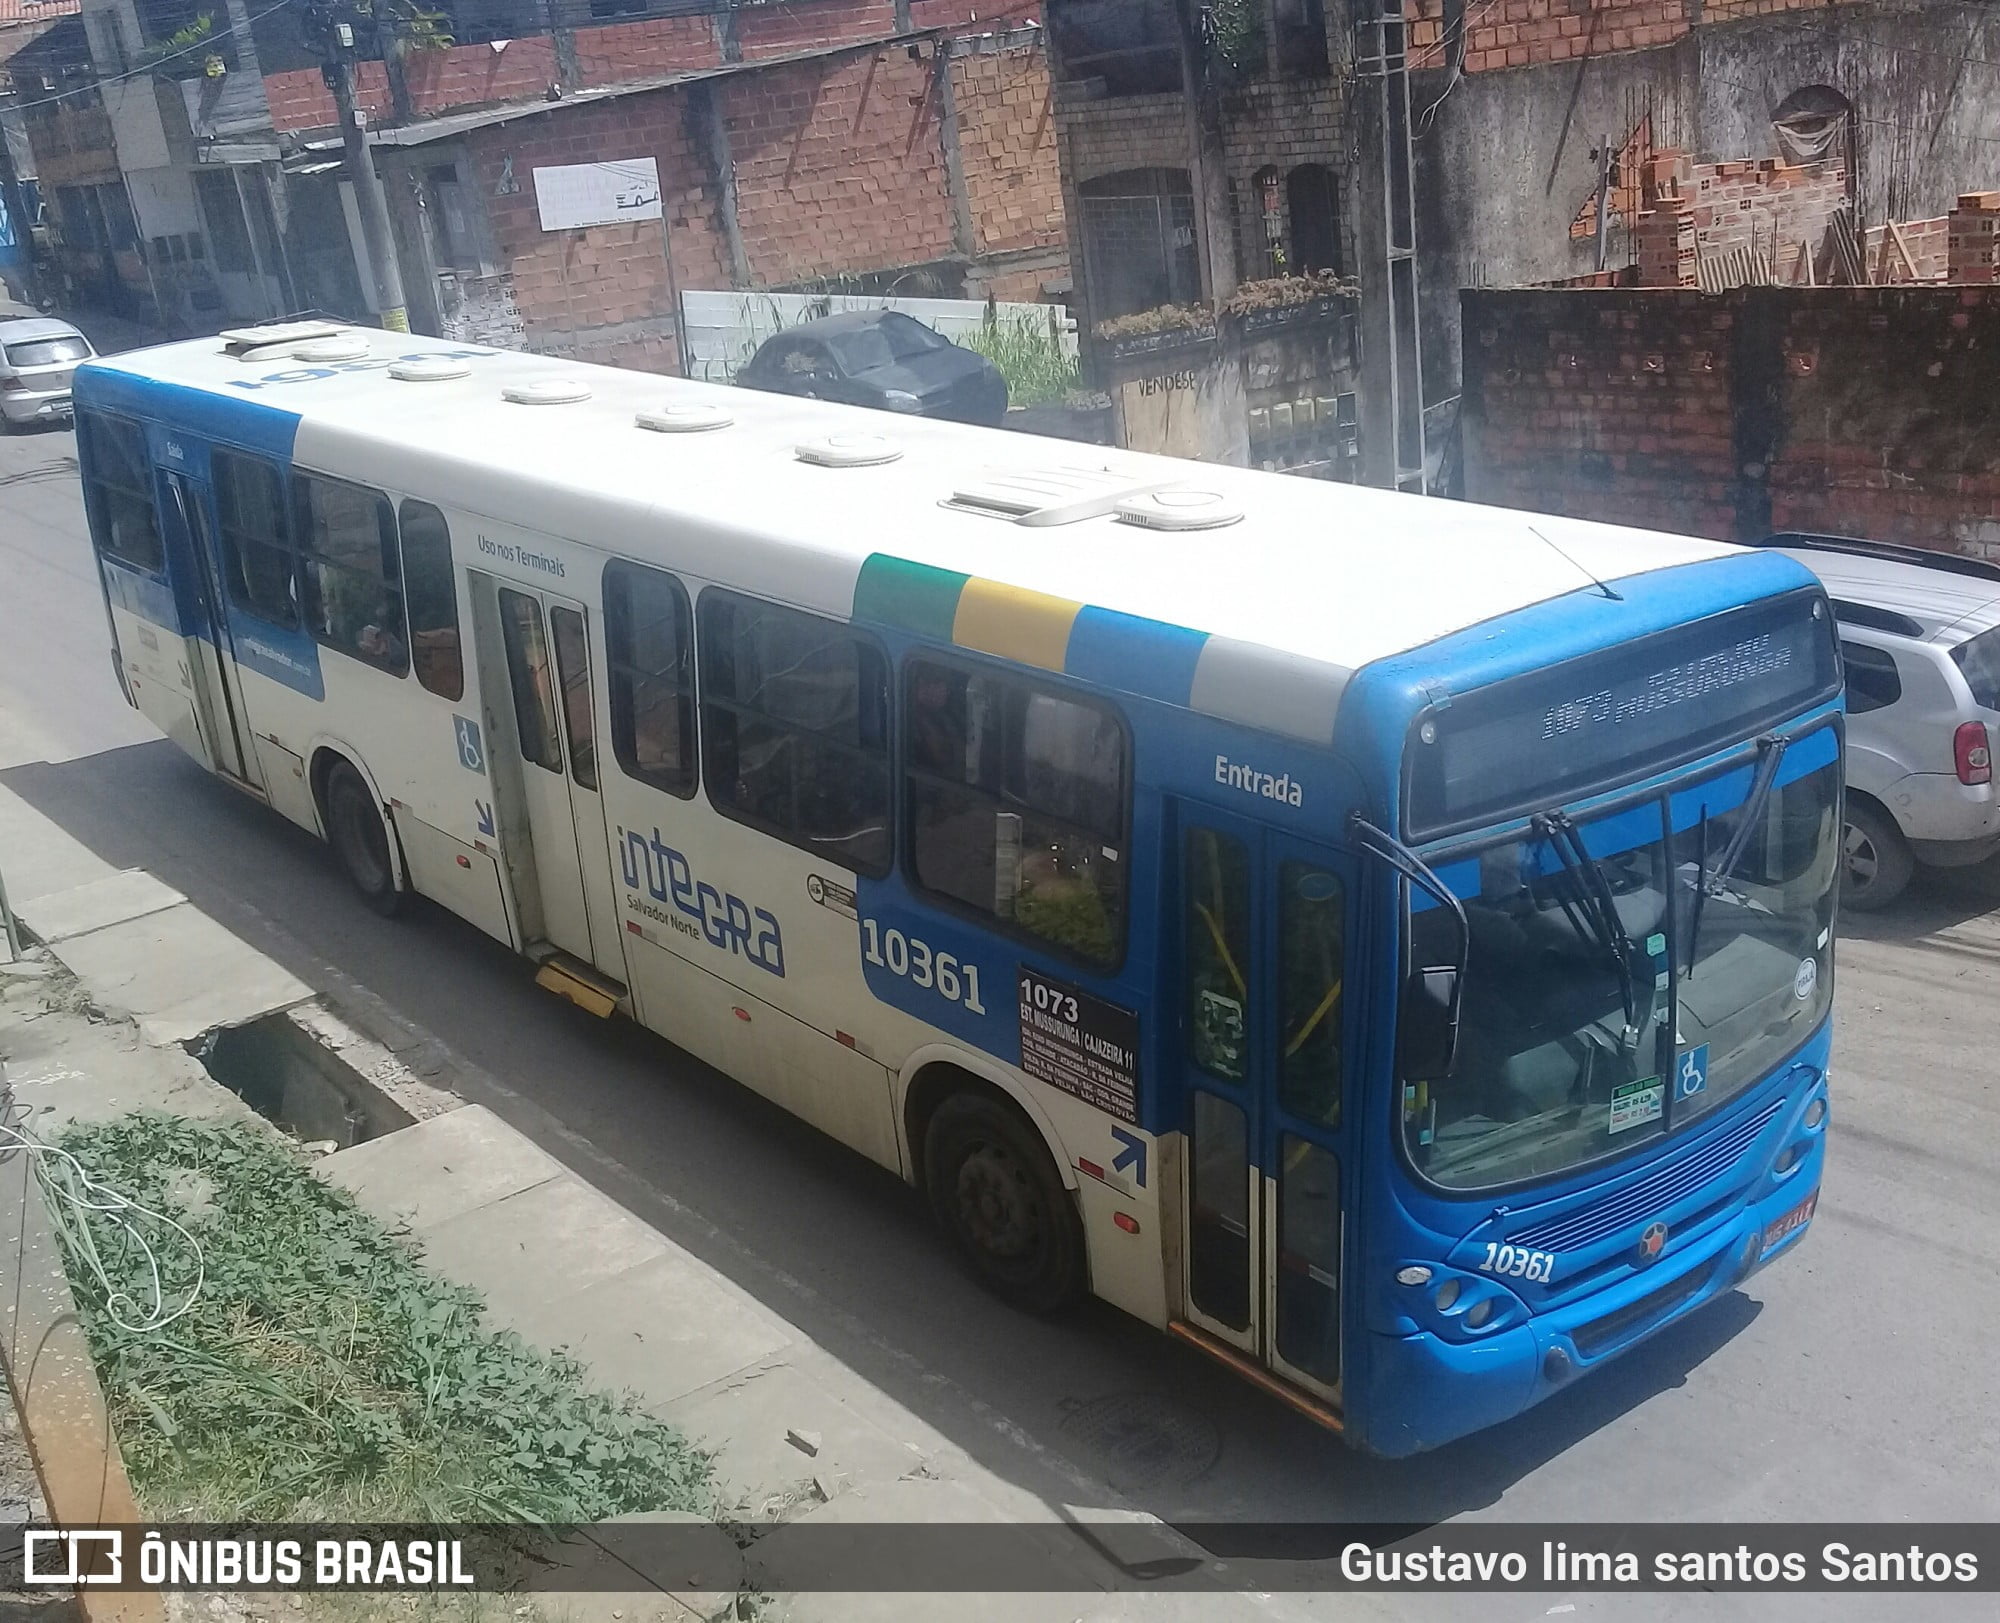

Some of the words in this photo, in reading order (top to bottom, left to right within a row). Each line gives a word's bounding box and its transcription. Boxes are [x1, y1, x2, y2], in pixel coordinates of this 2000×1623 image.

[478, 534, 496, 555] Uso
[498, 544, 514, 561] nos
[515, 546, 565, 577] Terminais
[1541, 689, 1611, 740] 1073
[1215, 754, 1303, 808] Entrada
[627, 894, 671, 926] Salvador
[671, 914, 700, 940] Norte
[864, 918, 986, 1016] 10361
[1021, 978, 1079, 1022] 1073
[1034, 1008, 1080, 1048] MUSSURUNGA
[1084, 1033, 1123, 1067] CAJAZEIRA
[1124, 1050, 1134, 1071] 11
[1478, 1242, 1555, 1283] 10361
